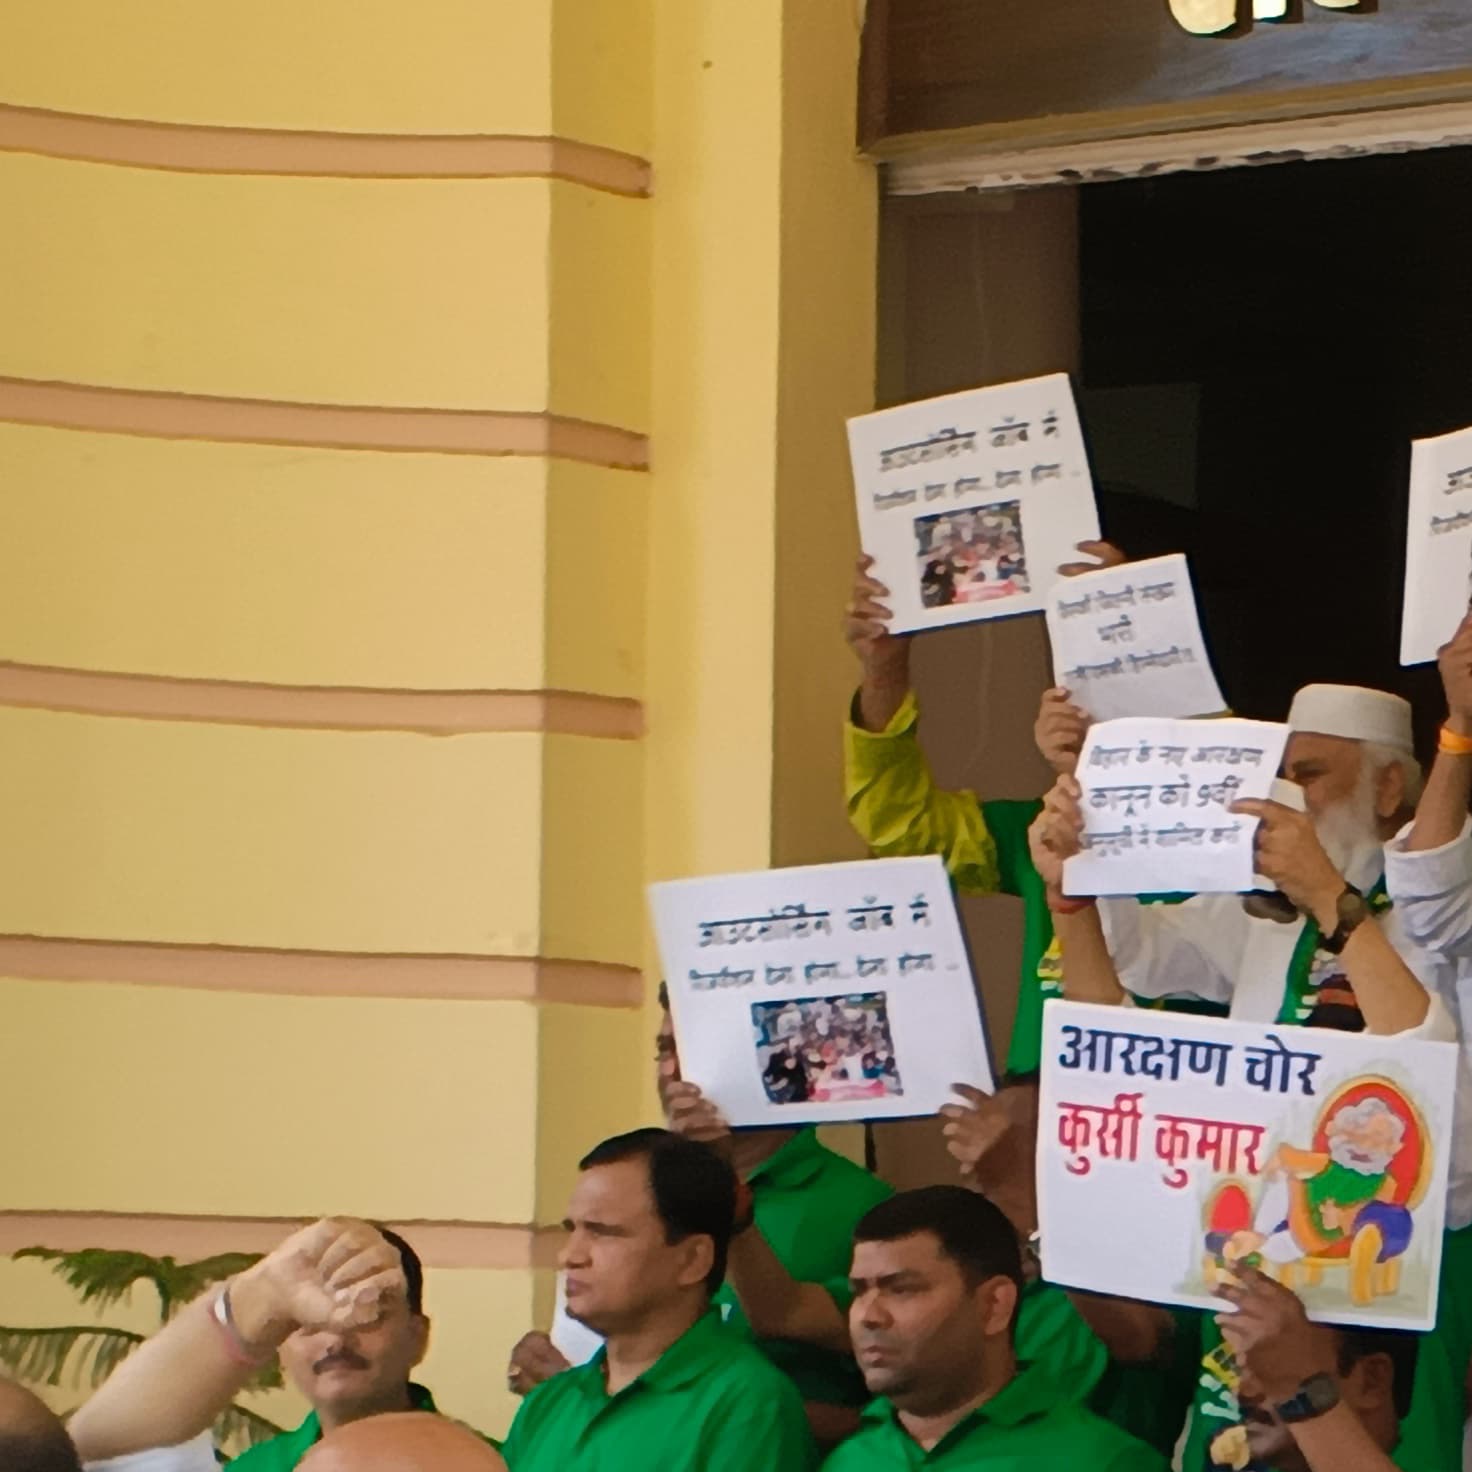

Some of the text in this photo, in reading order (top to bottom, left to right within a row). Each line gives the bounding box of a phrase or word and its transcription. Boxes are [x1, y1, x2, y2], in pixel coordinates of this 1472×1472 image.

[1058, 1024, 1322, 1096] आरक्षण चोर
[1058, 1092, 1267, 1189] कुर्सी कुमार
